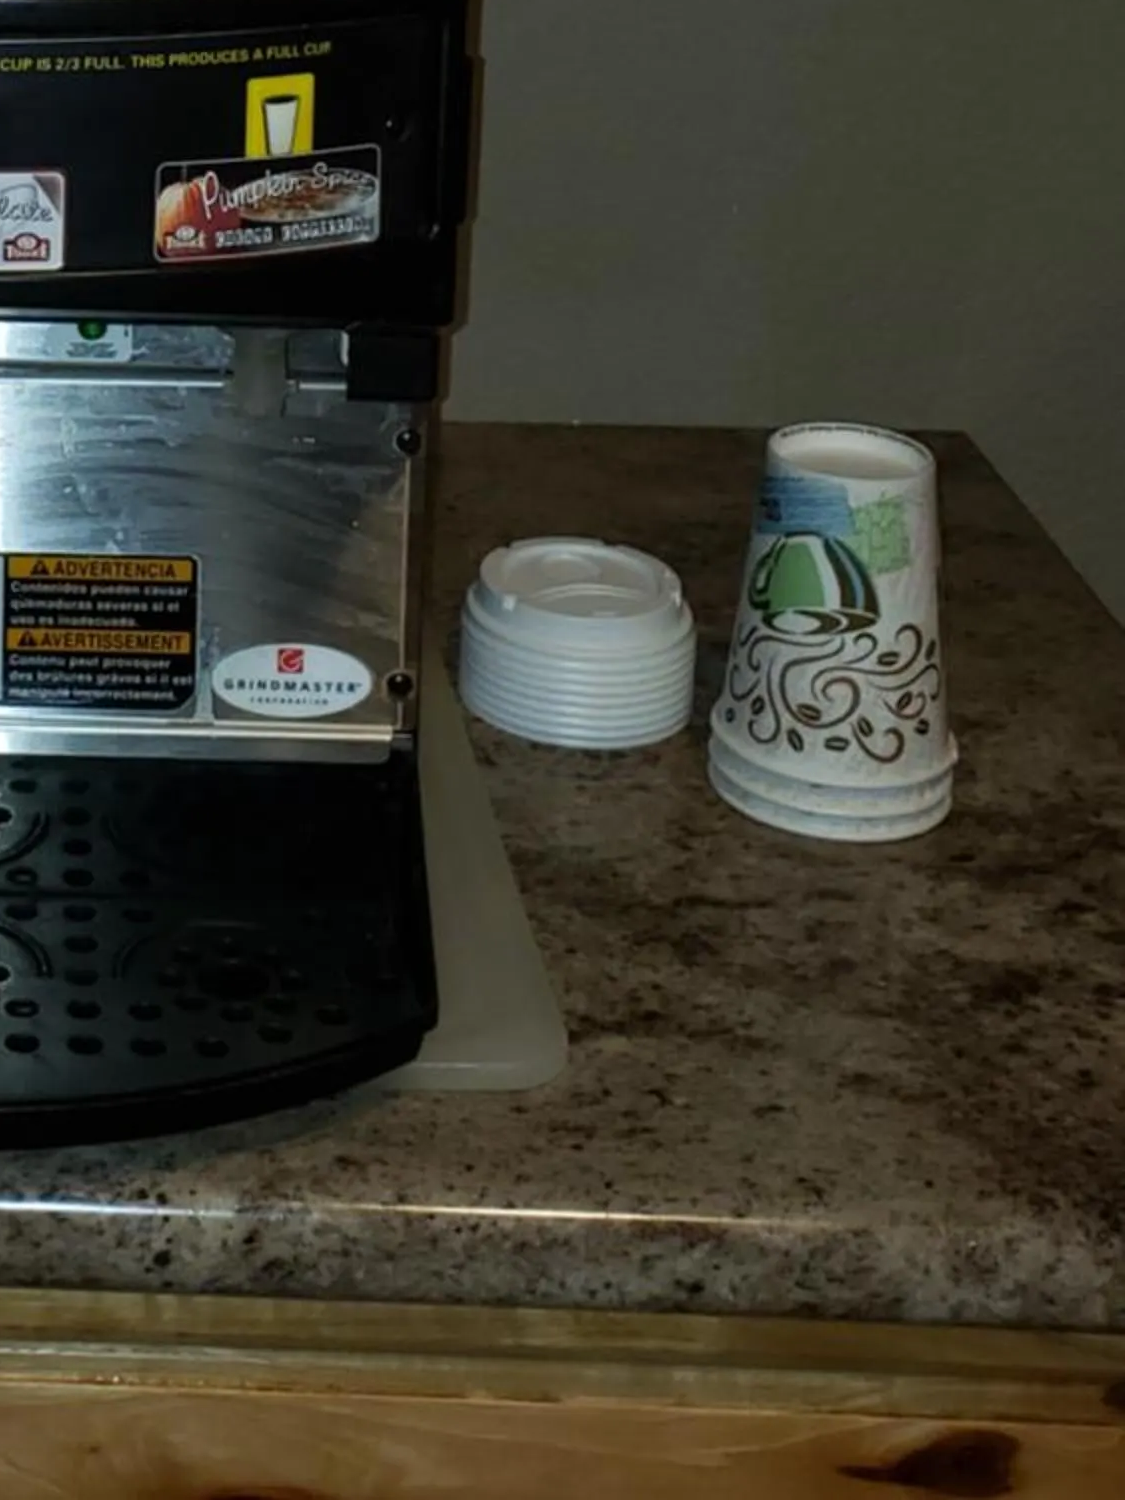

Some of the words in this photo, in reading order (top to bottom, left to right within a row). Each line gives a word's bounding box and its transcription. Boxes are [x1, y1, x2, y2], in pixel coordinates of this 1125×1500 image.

[35, 56, 52, 72] IS
[54, 56, 81, 72] 2/3
[130, 53, 166, 70] THIS
[167, 49, 250, 68] PRODUCES
[251, 49, 265, 61] A
[266, 45, 300, 61] FULL
[302, 40, 332, 57] CUP
[202, 170, 301, 220] Pumpkin
[311, 161, 369, 195] Spice
[53, 559, 177, 578] ADVERTENCIA
[41, 631, 182, 651] AVERTISSEMENT
